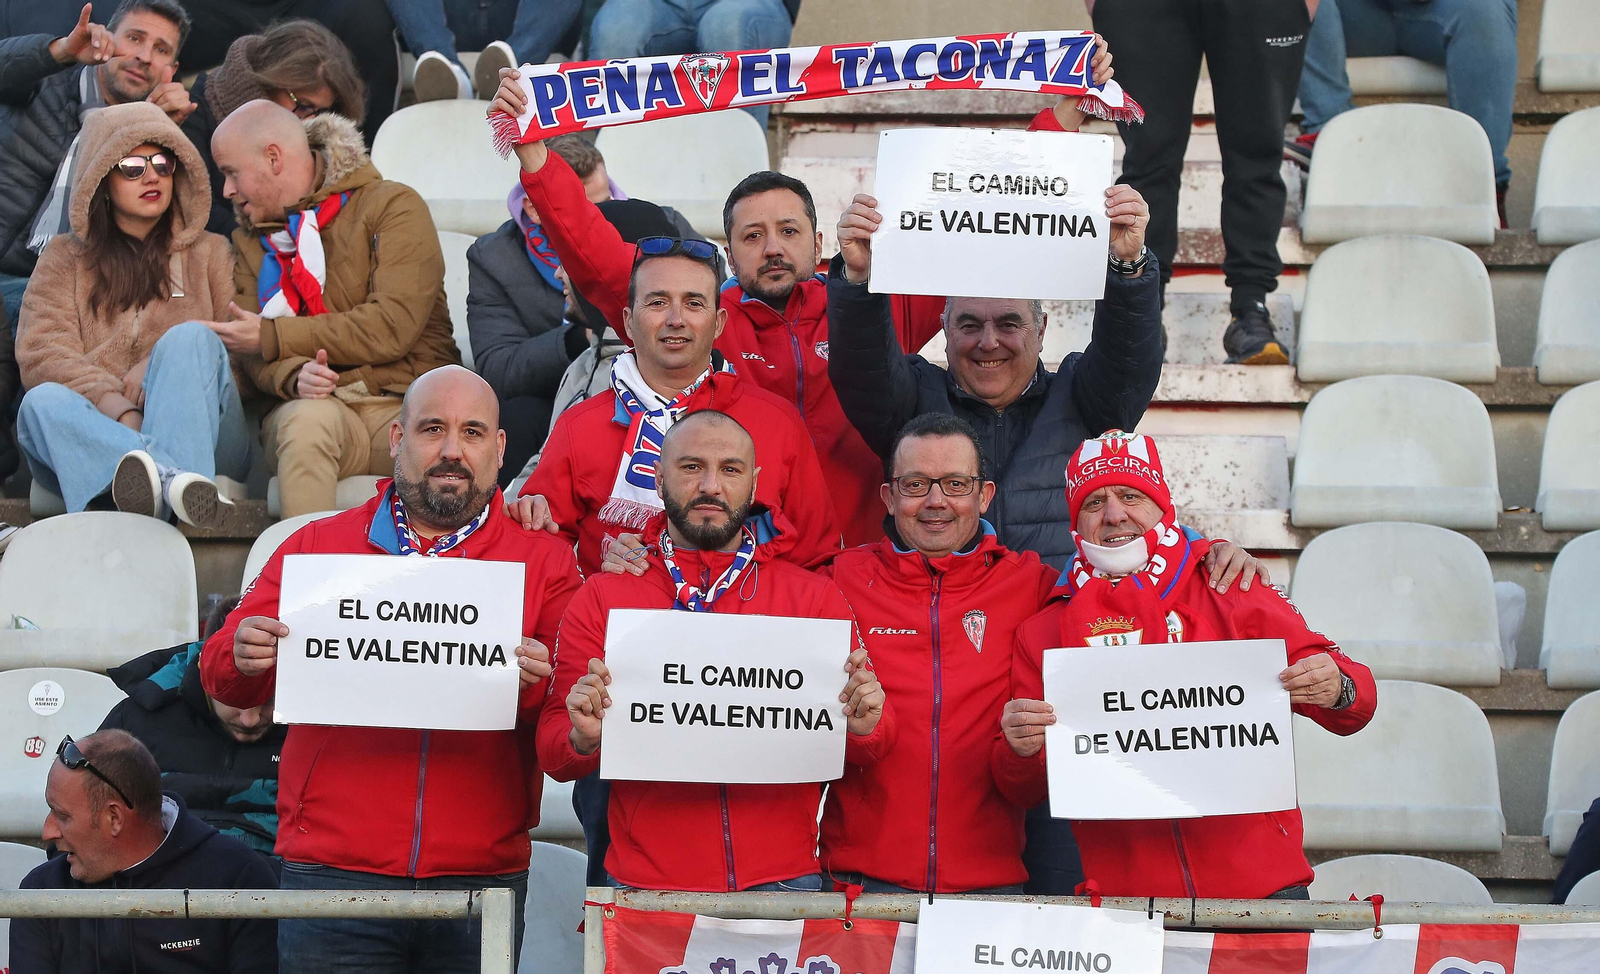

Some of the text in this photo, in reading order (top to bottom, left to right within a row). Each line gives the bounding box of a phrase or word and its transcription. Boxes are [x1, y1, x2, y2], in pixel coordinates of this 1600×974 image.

[529, 58, 684, 128] PEÑA
[738, 52, 806, 98] EL
[931, 172, 1069, 197] EL CAMINO
[899, 209, 1098, 239] DE VALENTINA
[1068, 457, 1161, 498] ALGECIRAS
[338, 598, 479, 626] EL CAMINO
[868, 626, 919, 635] Futura
[305, 637, 508, 668] DE VALENTINA
[662, 663, 804, 691] EL CAMINO
[1102, 684, 1245, 713] EL CAMINO
[630, 701, 834, 732] DE VALENTINA
[25, 738, 45, 754] 89
[1074, 722, 1280, 755] DE VALENTINA
[160, 938, 201, 950] MCKENZIE
[974, 944, 1112, 974] EL CAMINO
